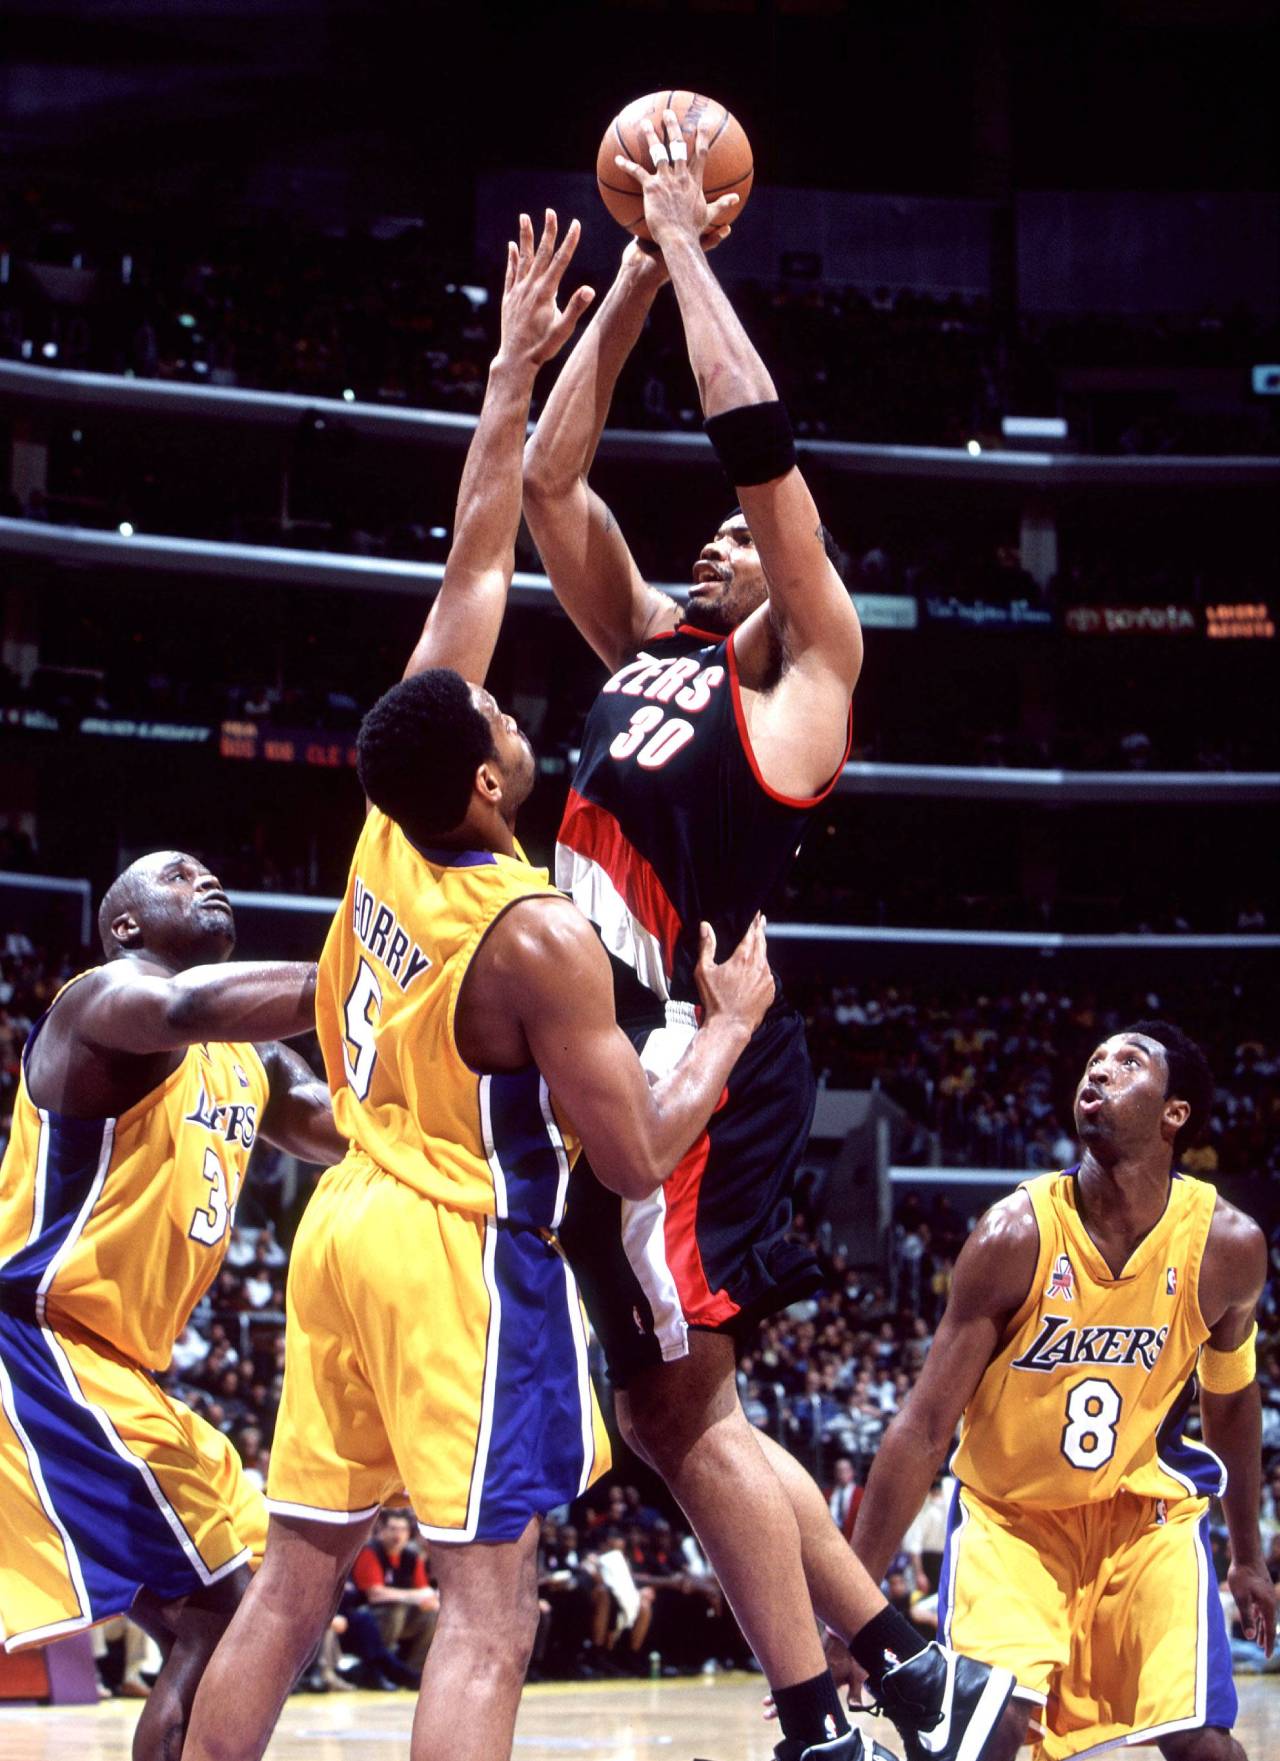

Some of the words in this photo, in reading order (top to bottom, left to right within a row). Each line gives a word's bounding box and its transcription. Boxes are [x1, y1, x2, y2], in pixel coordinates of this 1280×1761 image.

[608, 705, 696, 772] 30
[352, 874, 434, 993] HORRY
[342, 954, 384, 1104] 5
[1009, 1313, 1169, 1374] LAKERS
[1059, 1376, 1124, 1472] 8
